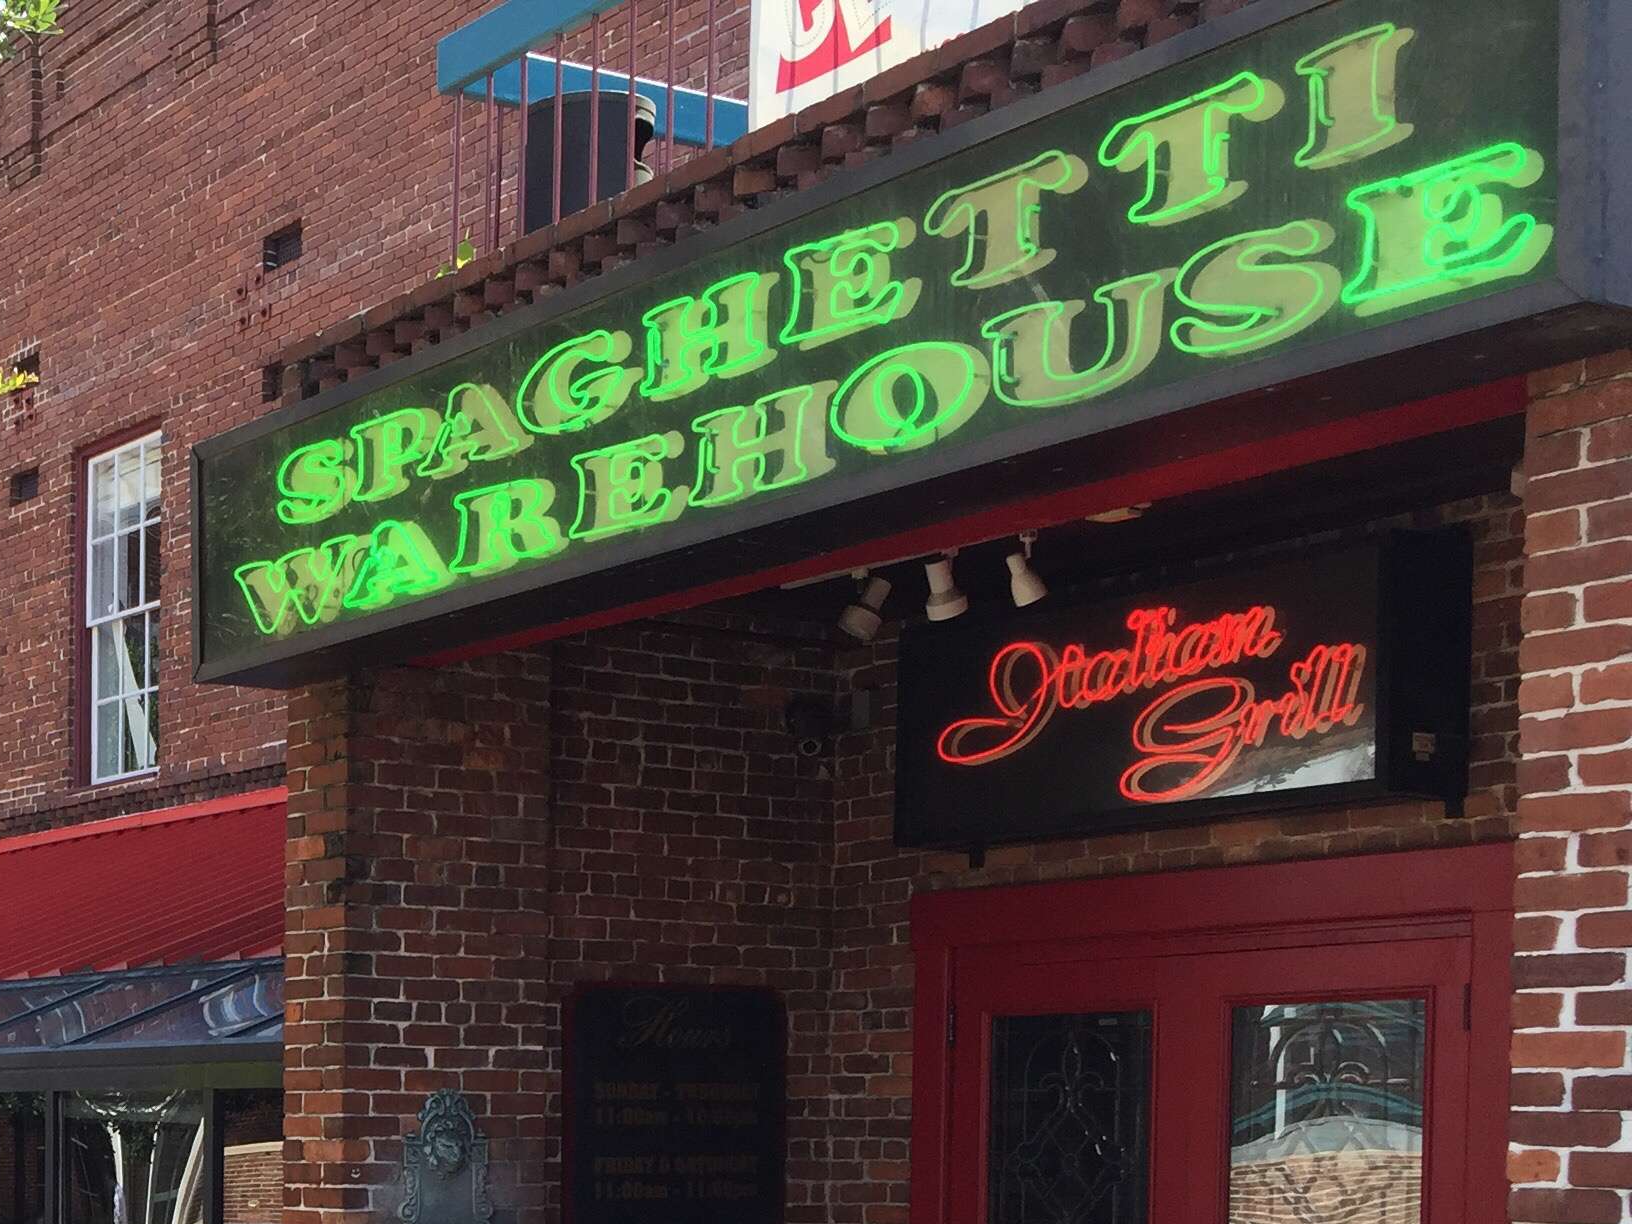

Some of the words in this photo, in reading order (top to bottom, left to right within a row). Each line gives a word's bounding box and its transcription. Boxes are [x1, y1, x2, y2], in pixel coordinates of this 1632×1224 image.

[277, 22, 1413, 526] SPAGHETTI
[234, 140, 1547, 638] WAREHOUSE
[937, 605, 1285, 765] Italian
[1120, 642, 1366, 803] Grill
[616, 995, 730, 1048] Hours
